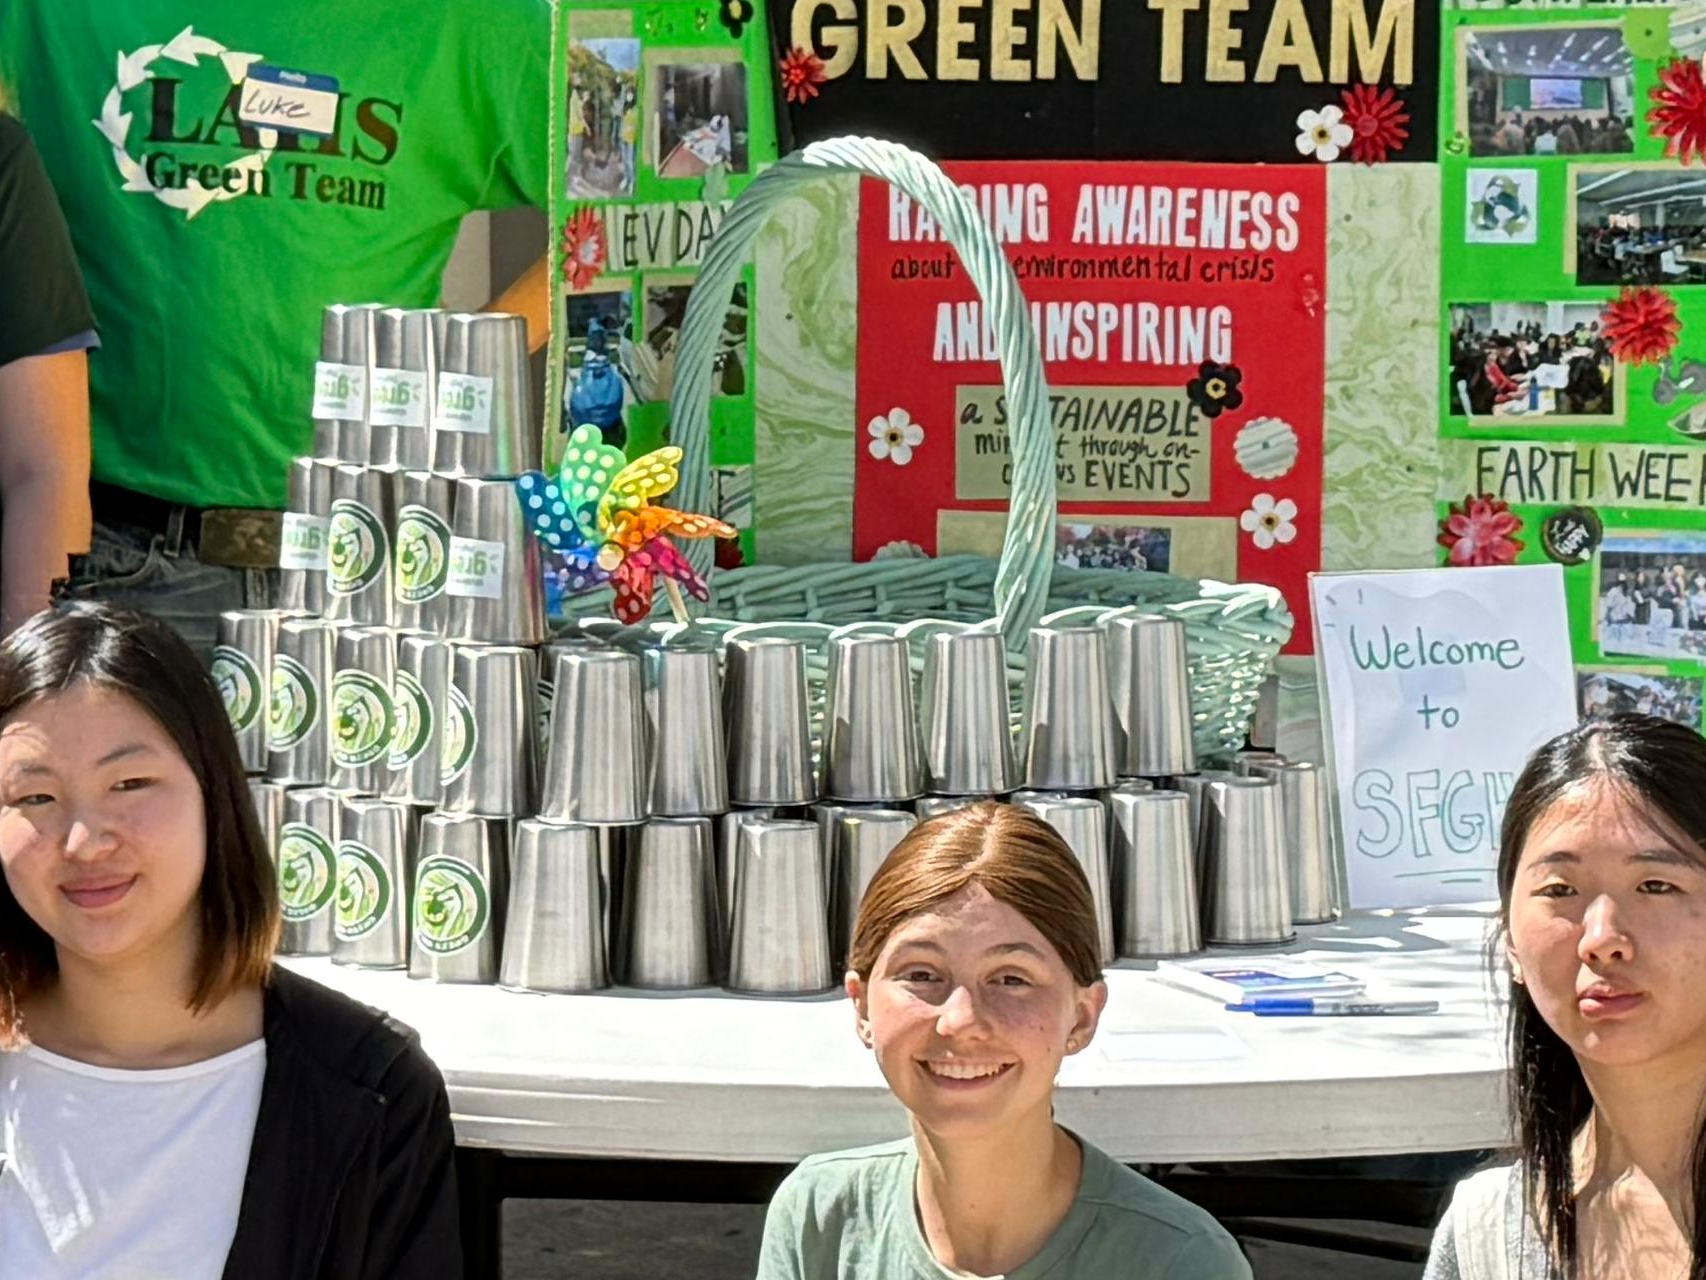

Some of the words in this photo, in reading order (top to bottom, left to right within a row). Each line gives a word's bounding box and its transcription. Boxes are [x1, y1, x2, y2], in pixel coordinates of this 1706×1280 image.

[143, 77, 403, 166] LAS
[146, 151, 272, 197] Green
[284, 161, 387, 210] Team
[675, 201, 735, 265] DA
[1071, 183, 1300, 252] AWARENESS
[890, 255, 955, 282] about
[1199, 256, 1275, 282] crisis
[1031, 301, 1232, 365] INSPIRING
[993, 395, 1200, 437] STAINABLE
[1081, 433, 1156, 463] through
[1084, 460, 1191, 497] EVENTS
[1477, 446, 1595, 503] EARTH
[1349, 624, 1526, 671] Welcome
[1416, 694, 1460, 730] to
